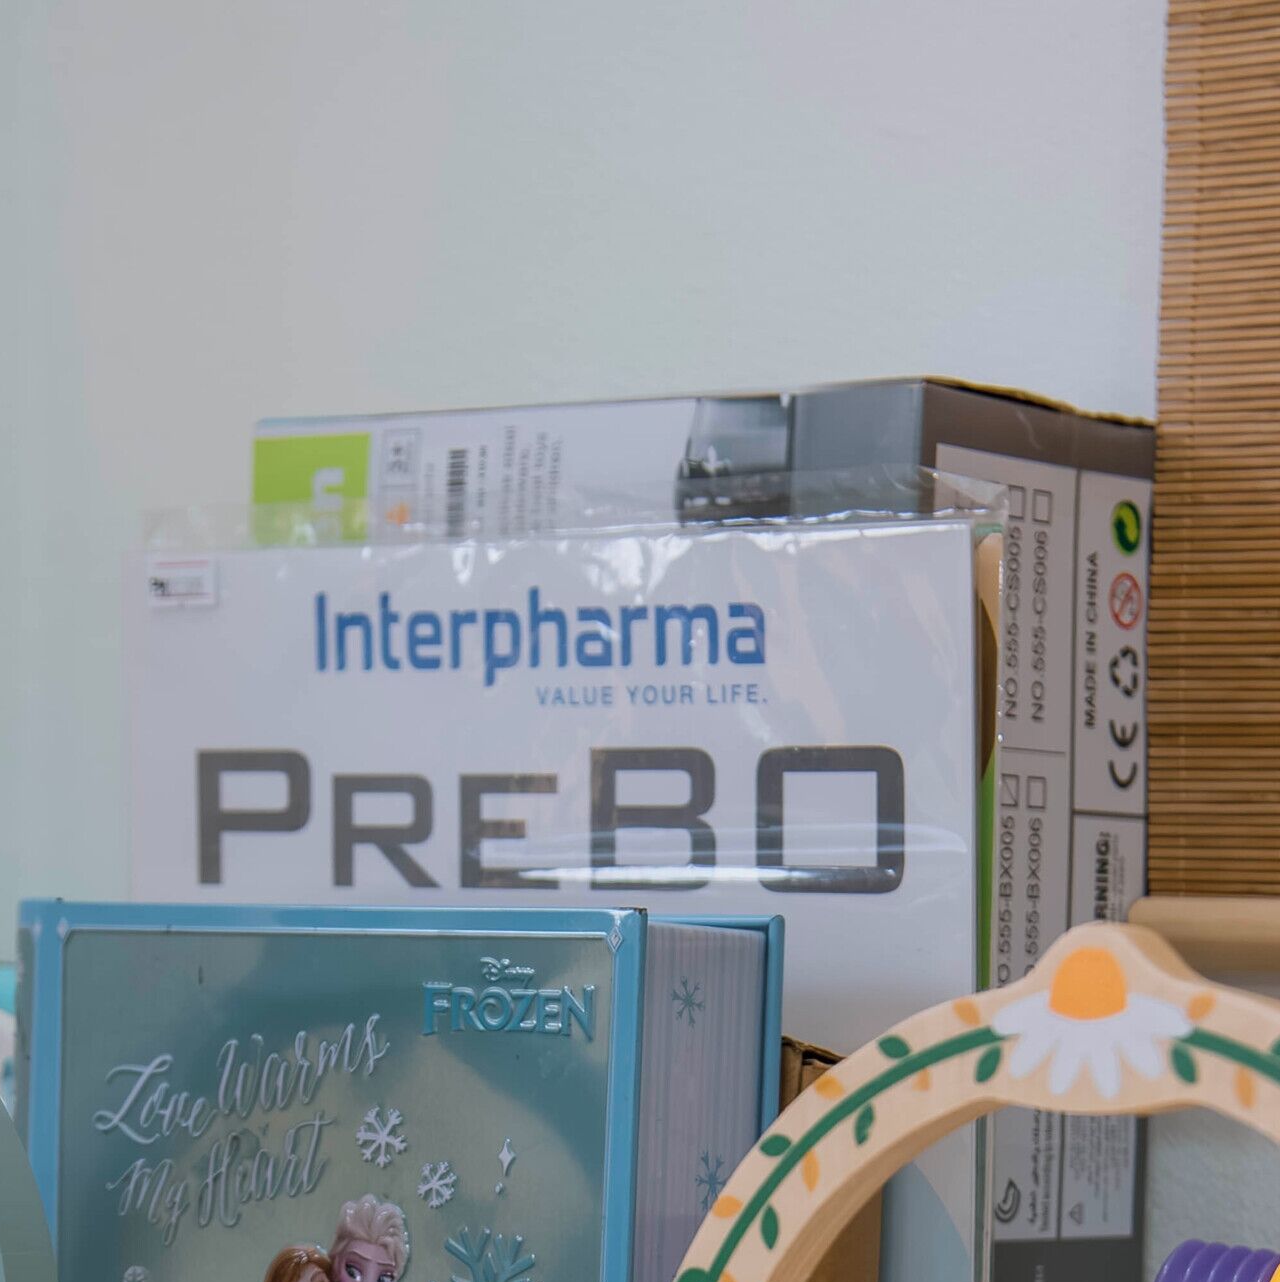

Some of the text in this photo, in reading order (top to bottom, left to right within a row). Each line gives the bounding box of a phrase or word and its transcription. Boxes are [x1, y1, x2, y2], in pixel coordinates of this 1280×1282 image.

[315, 587, 766, 688] Interpharma
[1083, 552, 1099, 730] MADE IN CHINA
[536, 683, 769, 706] VALUE YOUR LIFE.
[1094, 831, 1111, 920] RNING:
[421, 981, 596, 1041] FROZEN
[480, 956, 535, 989] Disney
[92, 1012, 391, 1145] Love Warms
[105, 1110, 336, 1248] My Heart
